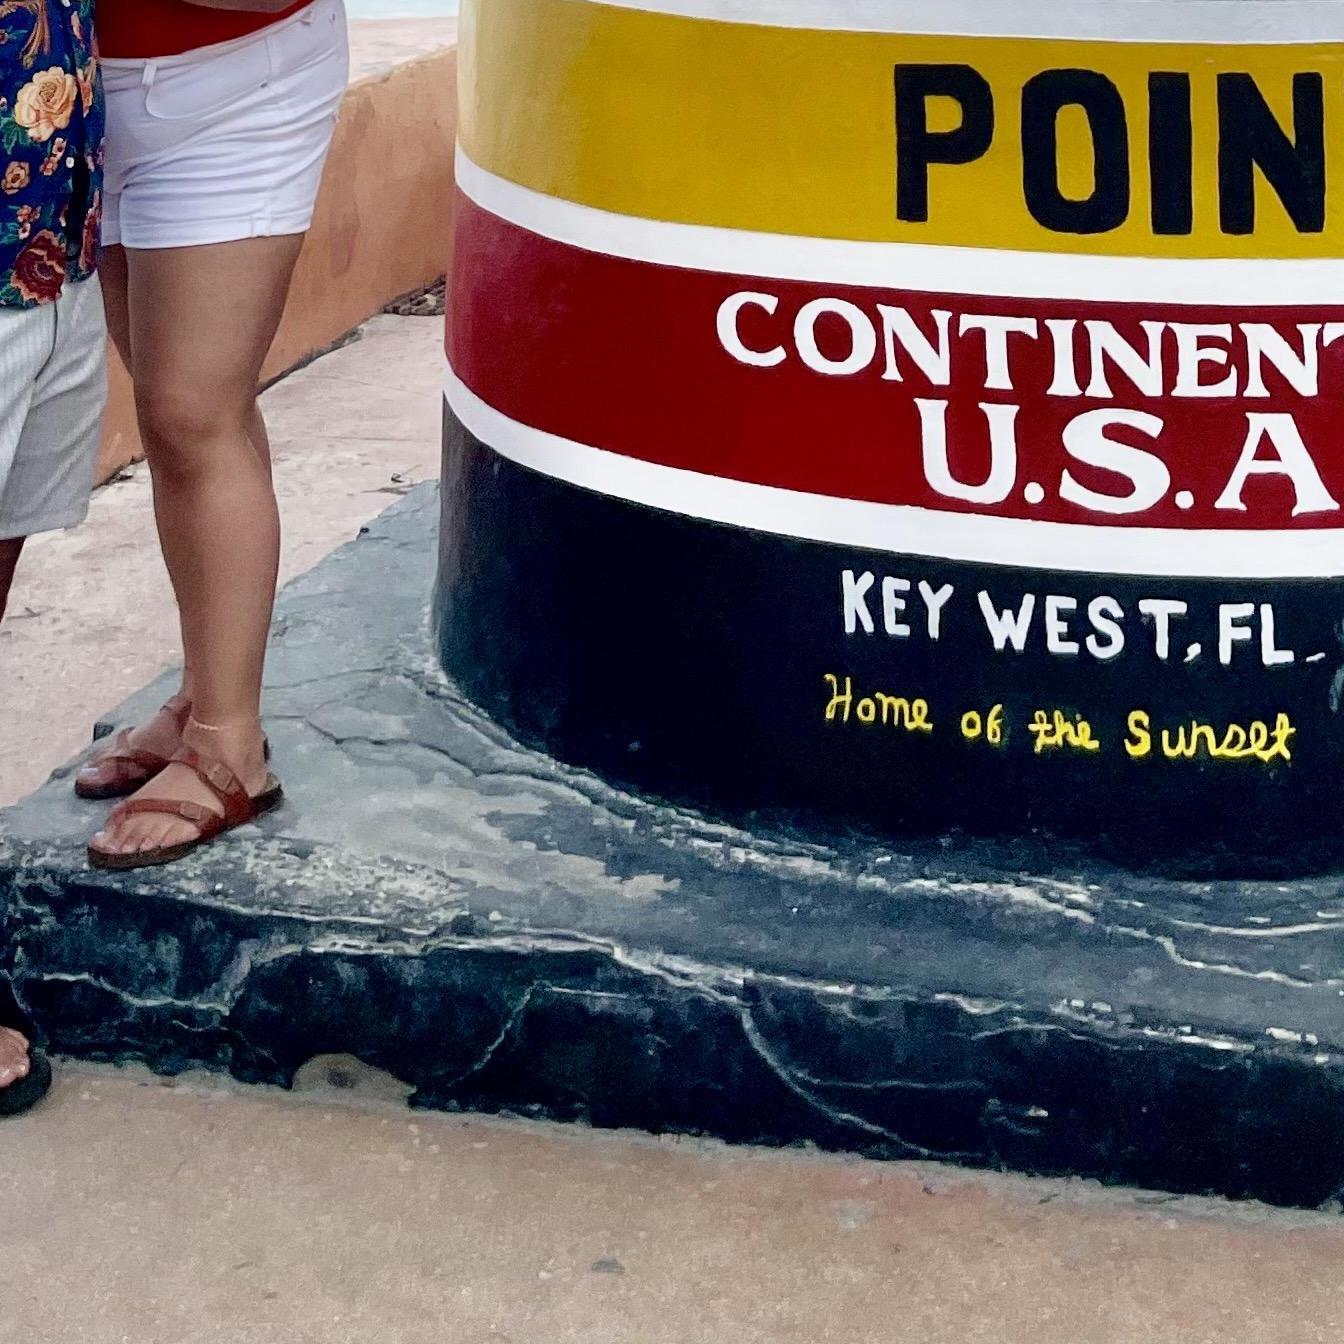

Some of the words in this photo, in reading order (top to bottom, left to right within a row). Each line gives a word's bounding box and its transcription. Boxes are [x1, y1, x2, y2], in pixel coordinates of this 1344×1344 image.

[840, 569, 955, 640] KEY
[823, 673, 934, 732] Home
[959, 704, 1003, 745] of
[1028, 709, 1099, 756] the
[1123, 709, 1296, 763] Sunset
